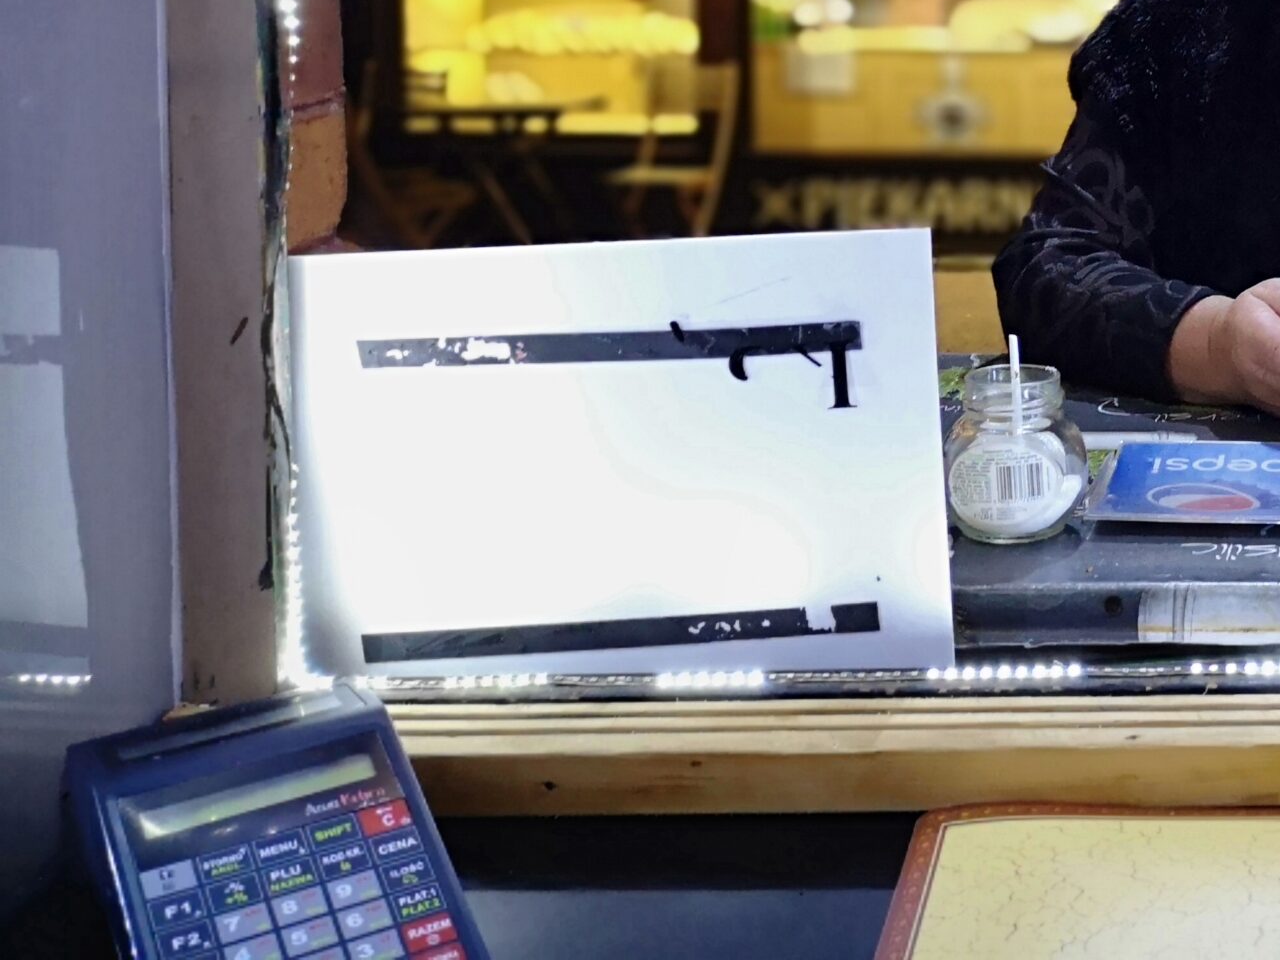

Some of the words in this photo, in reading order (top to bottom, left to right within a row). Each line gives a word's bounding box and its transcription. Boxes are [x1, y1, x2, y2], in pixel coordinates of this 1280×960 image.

[382, 814, 395, 827] C
[314, 823, 353, 842] SHIFT
[259, 839, 298, 859] MENU
[378, 836, 418, 855] CENA
[270, 863, 302, 881] PLU
[335, 883, 353, 899] 9
[164, 901, 191, 920] F1
[280, 899, 298, 915] 8
[401, 897, 442, 918] PLAT.2
[223, 915, 241, 933] 7
[345, 912, 364, 928] 6
[407, 917, 452, 939] RAZEM
[171, 932, 202, 951] F2
[355, 943, 375, 958] 3
